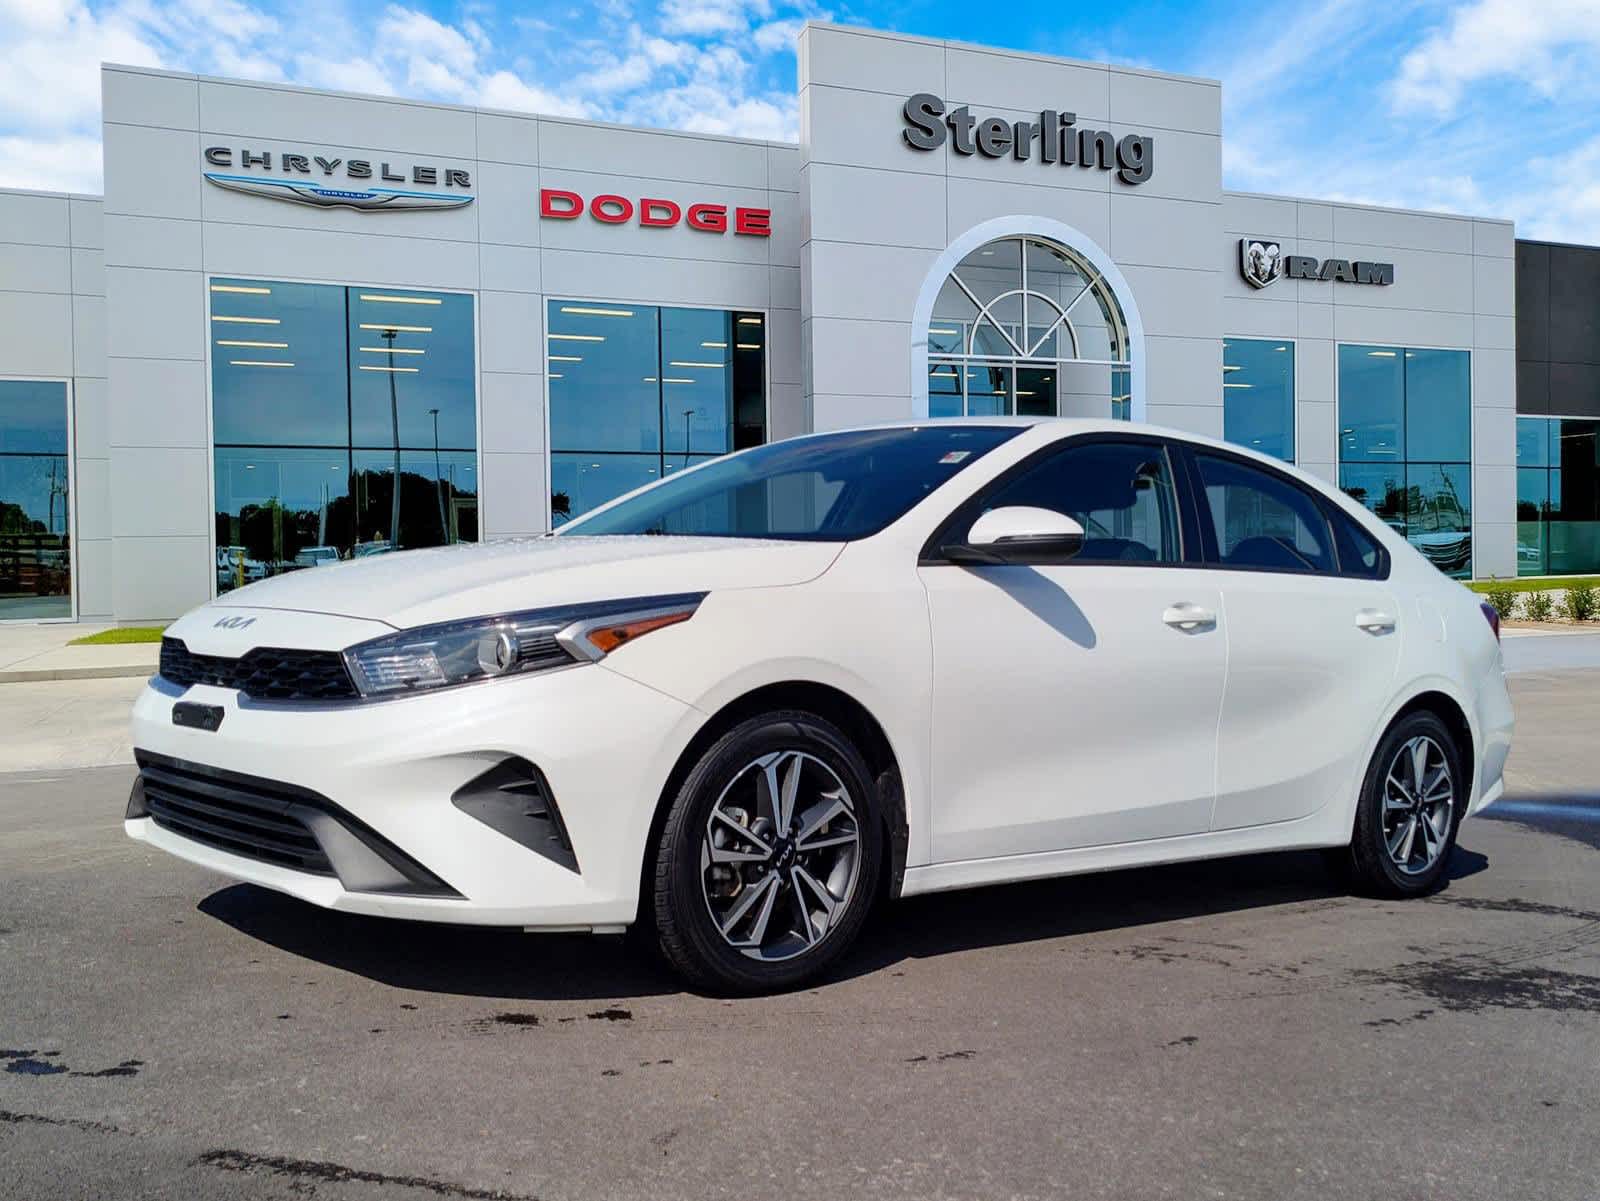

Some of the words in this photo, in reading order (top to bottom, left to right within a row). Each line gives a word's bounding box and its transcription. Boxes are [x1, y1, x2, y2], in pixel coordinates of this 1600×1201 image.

[903, 93, 1153, 184] Sterling
[204, 147, 471, 187] CHRYSLER
[540, 188, 771, 236] DODGE
[1284, 255, 1394, 286] RAM
